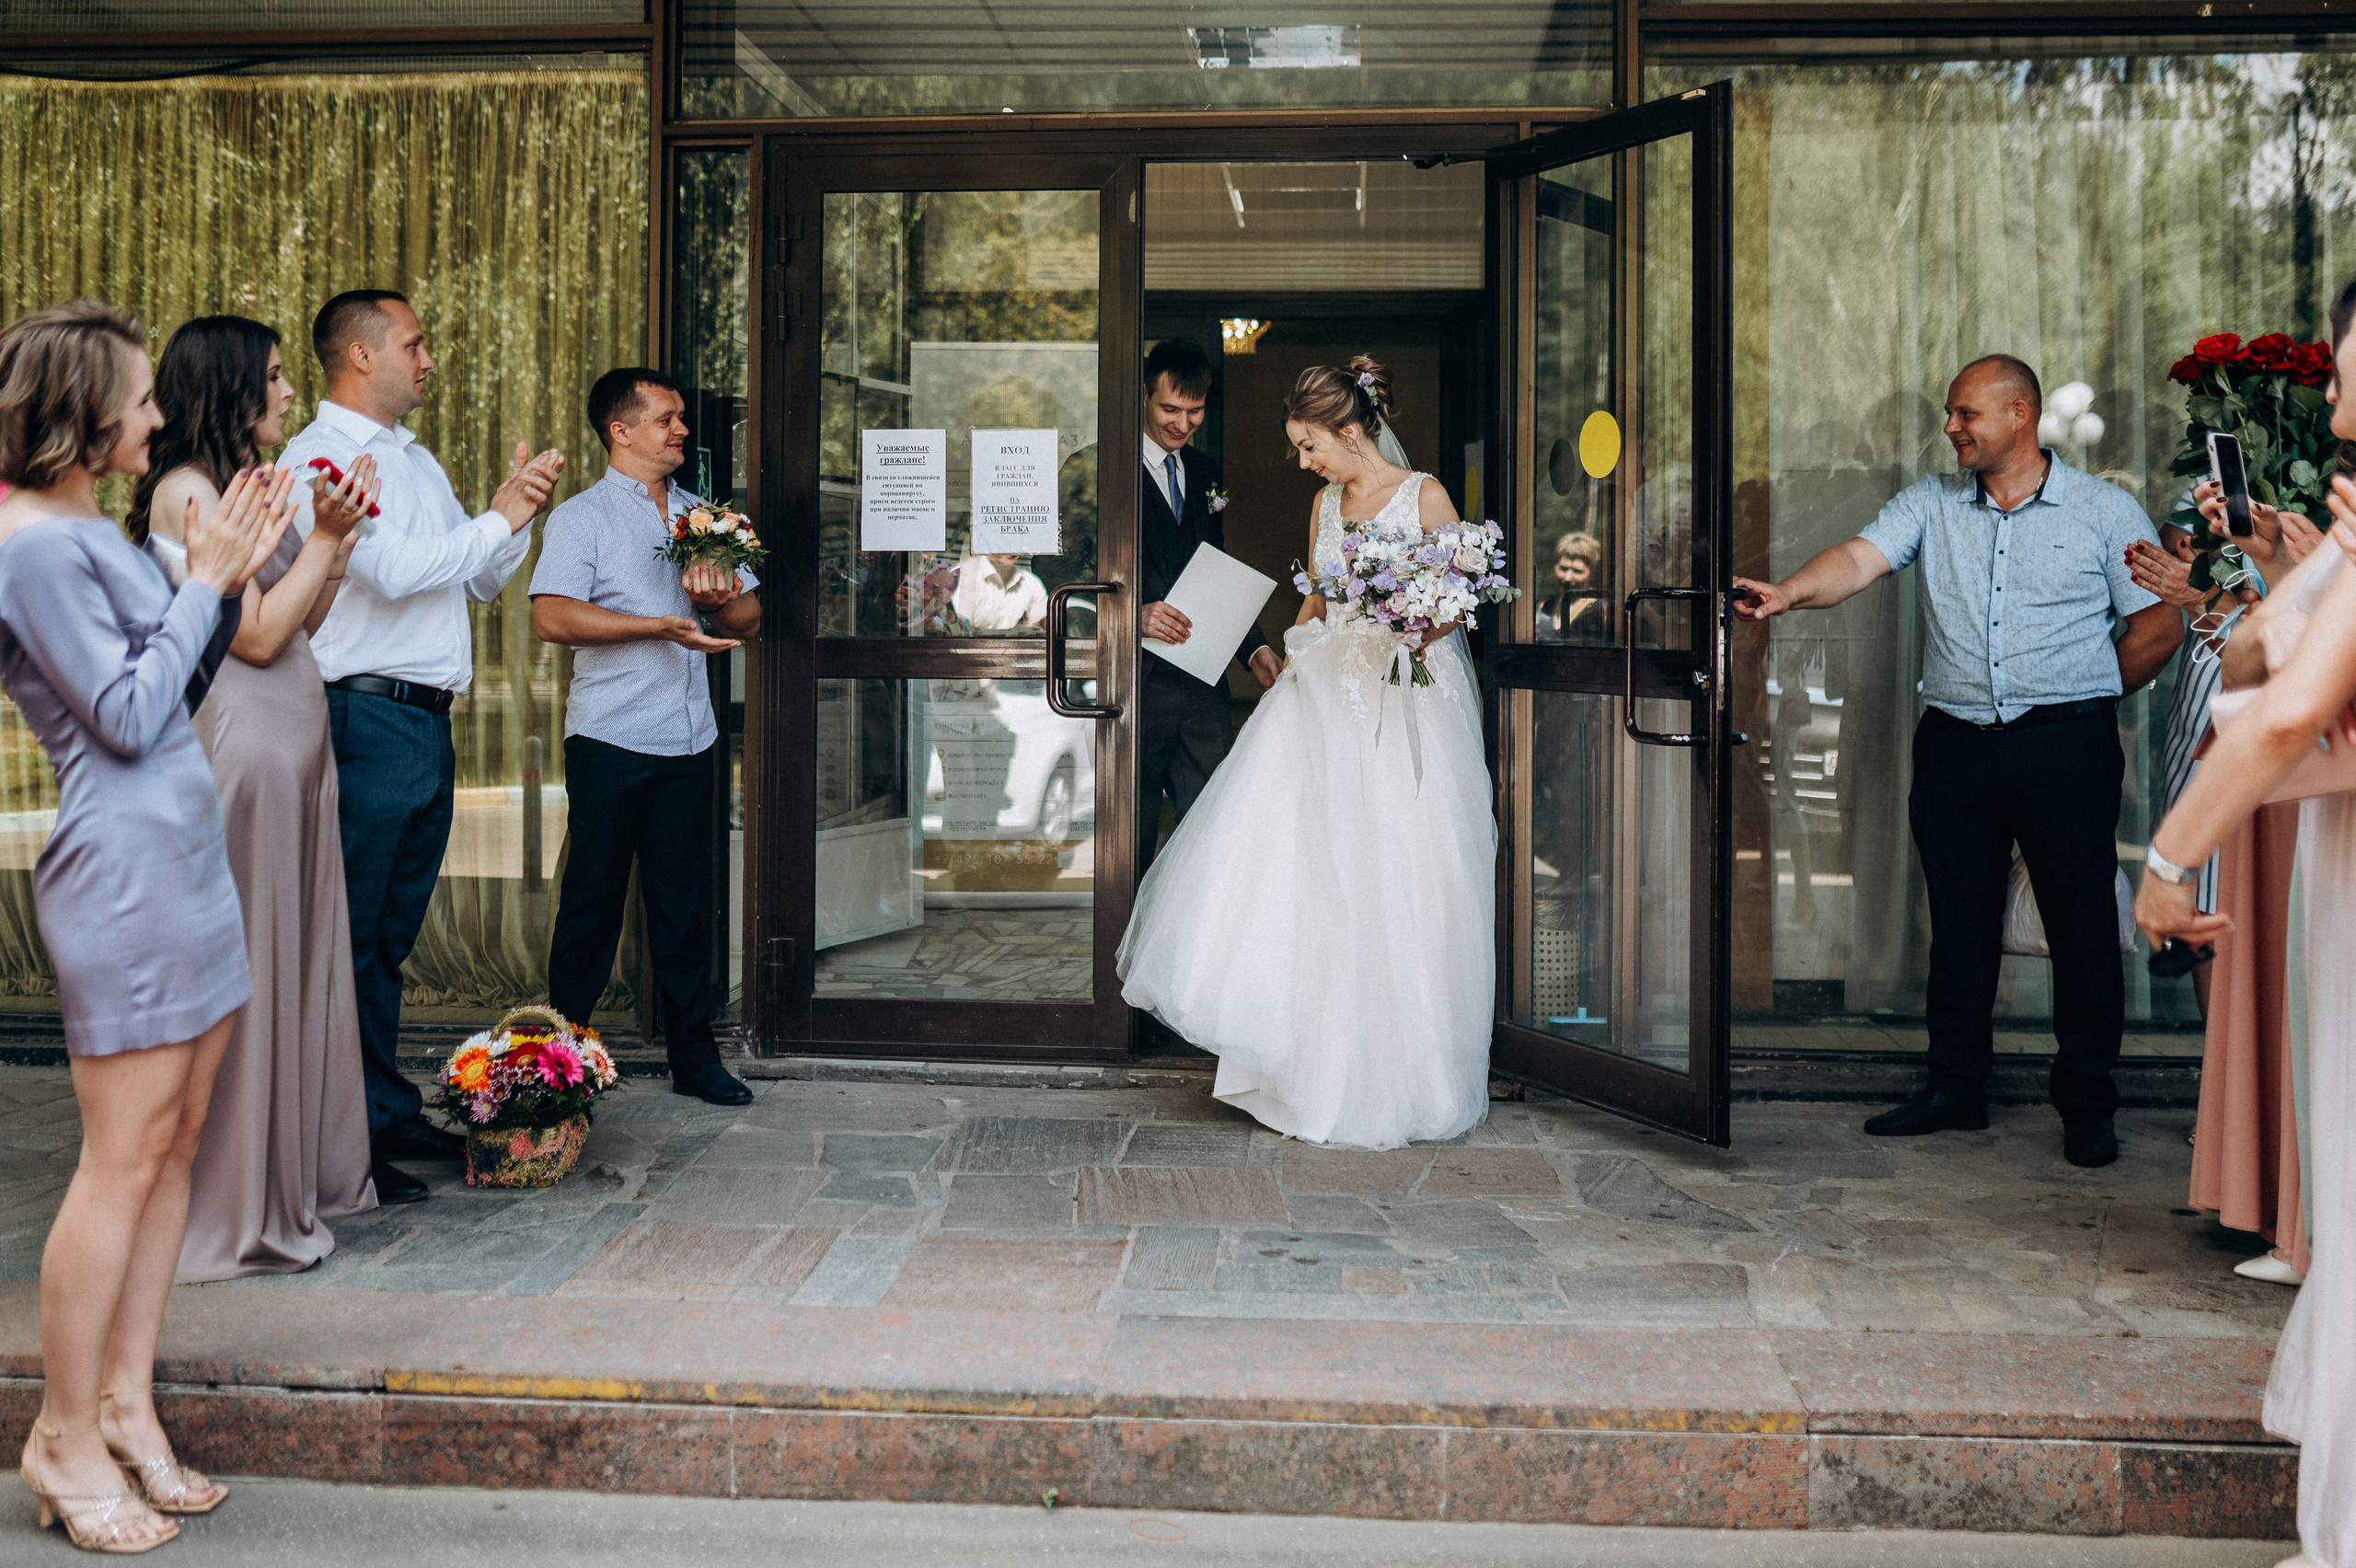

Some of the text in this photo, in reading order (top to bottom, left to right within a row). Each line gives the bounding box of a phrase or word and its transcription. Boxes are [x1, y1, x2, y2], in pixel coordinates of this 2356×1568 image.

[876, 444, 930, 453] Уважаемые
[1000, 446, 1030, 455] ВХОД
[880, 455, 926, 465] граждане!
[980, 505, 1050, 513] РЕГИСТРАЦИЮ
[983, 515, 1047, 524] ЗАКЛЮЧЕНИЯ
[999, 525, 1030, 533] БРАКА
[934, 855, 949, 865] +7
[957, 854, 980, 865] 495
[987, 854, 1009, 865] 107
[1038, 854, 1054, 865] 22
